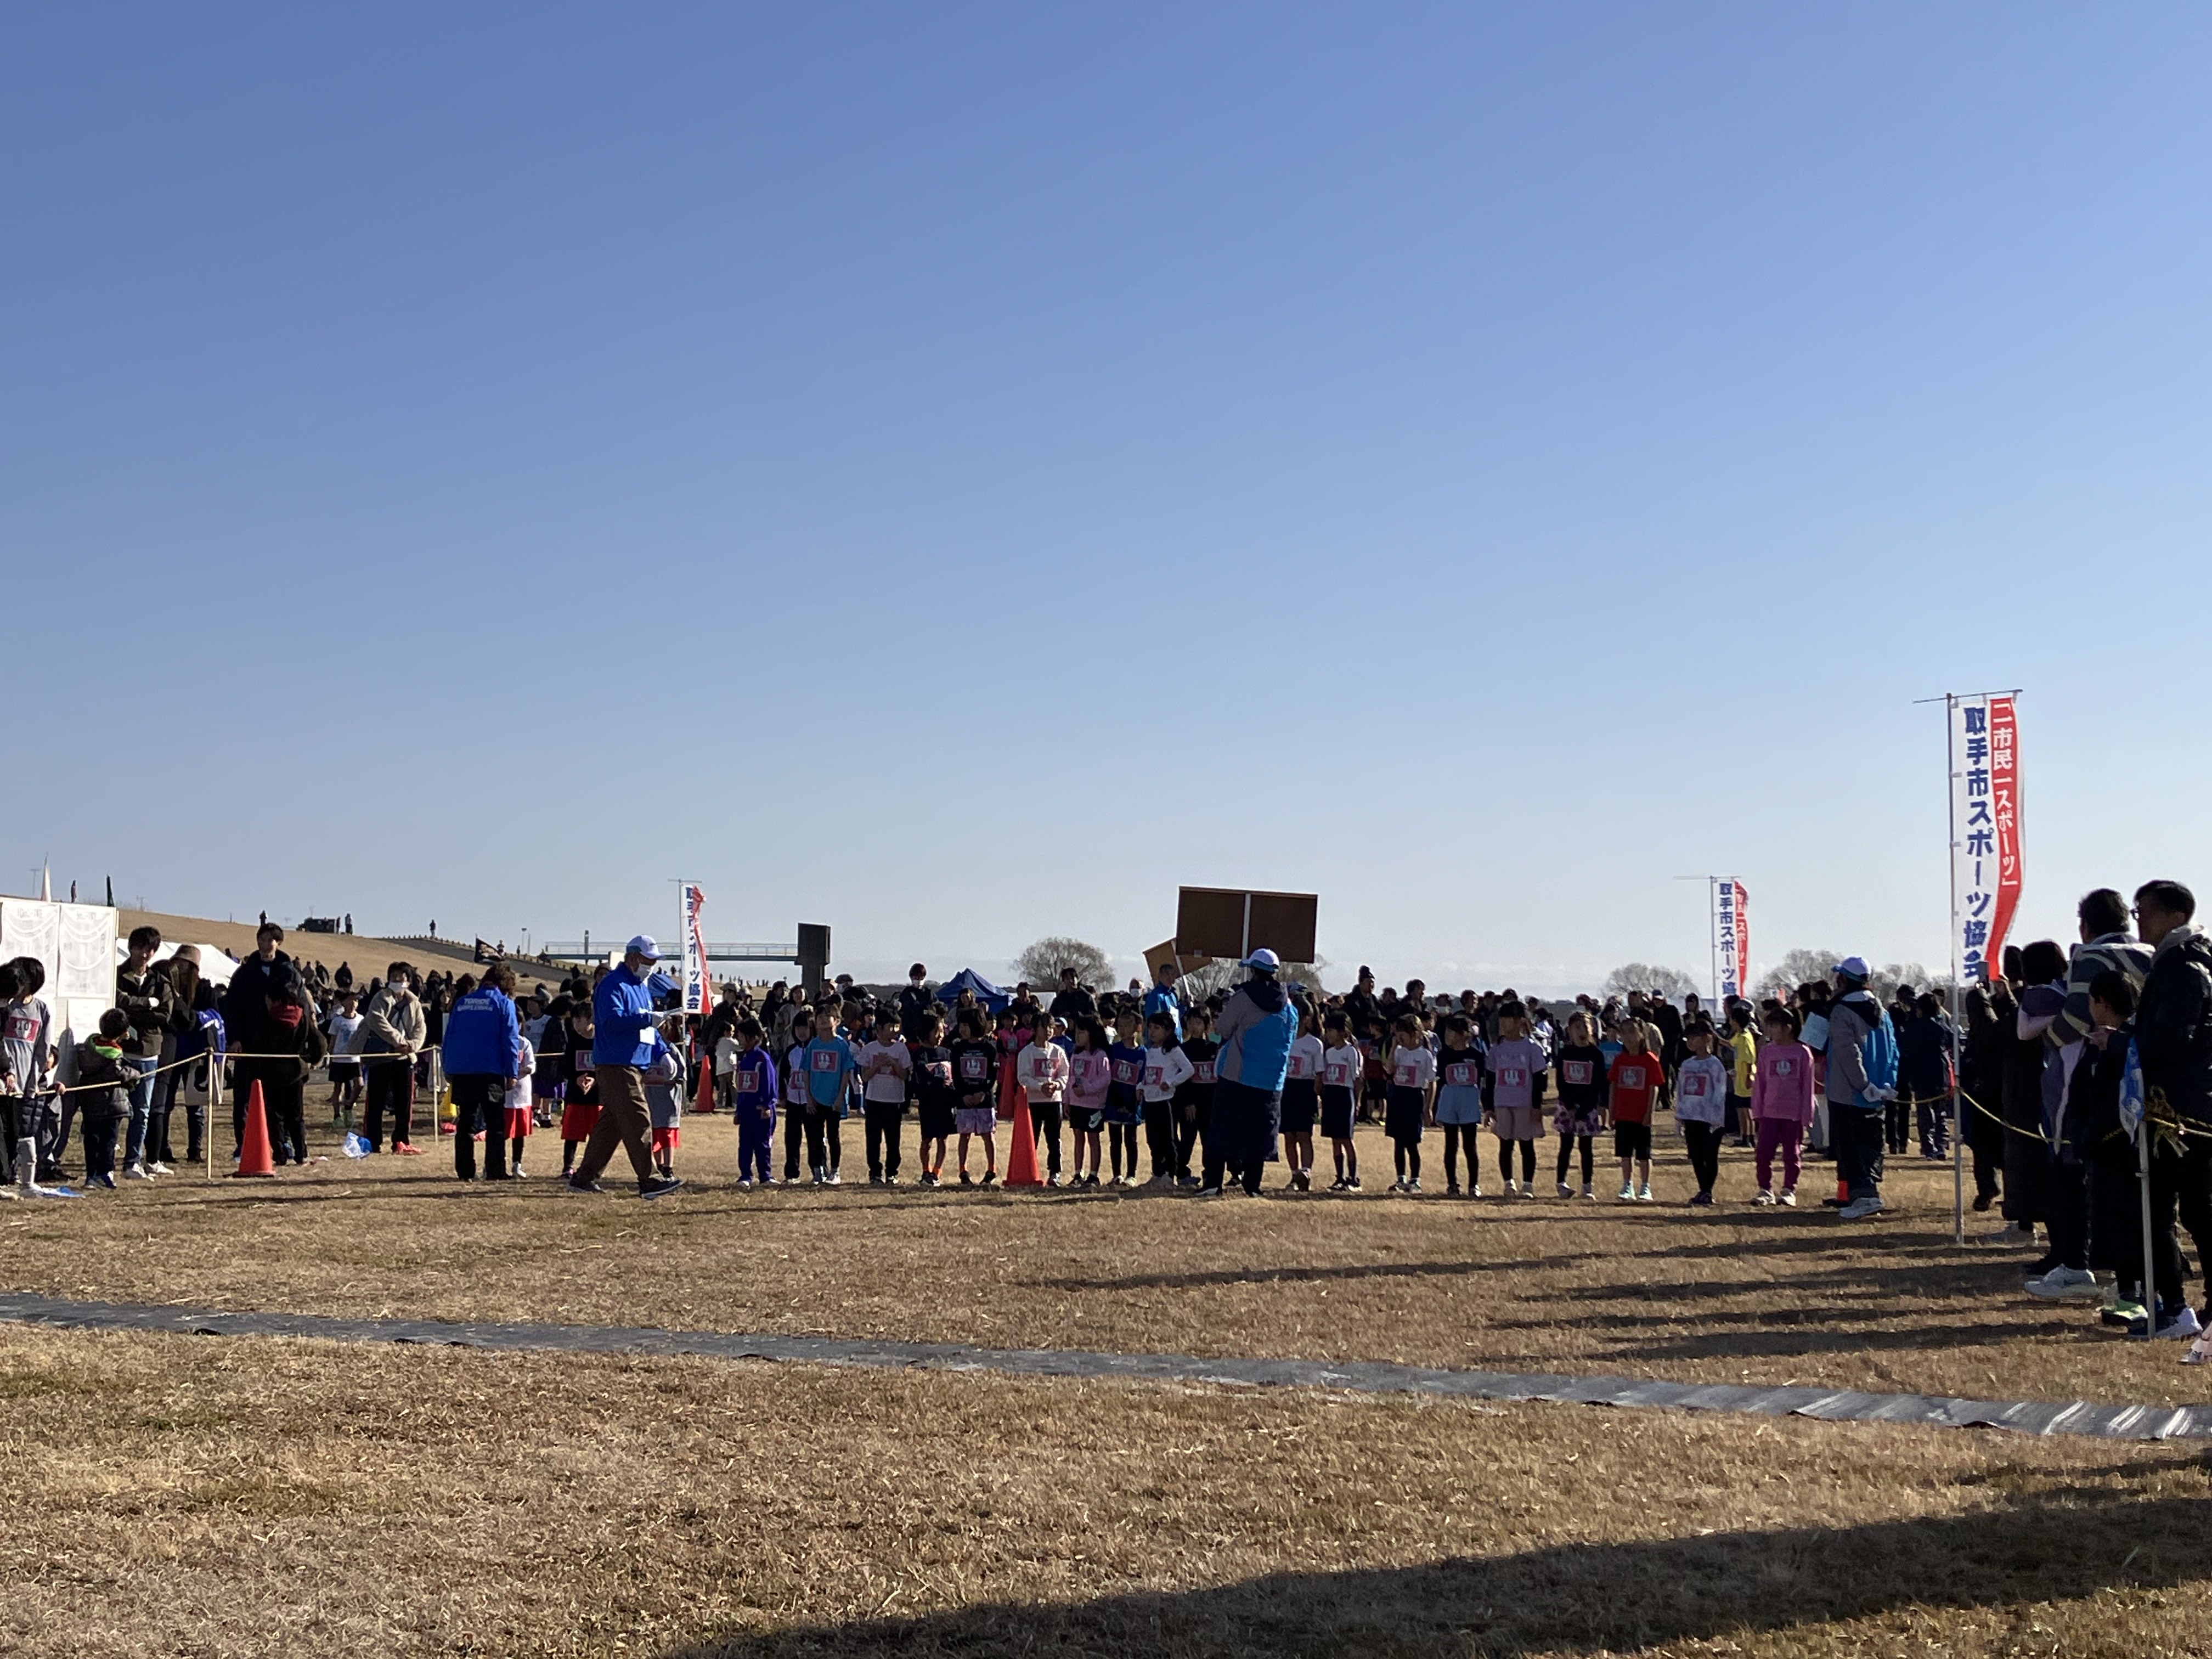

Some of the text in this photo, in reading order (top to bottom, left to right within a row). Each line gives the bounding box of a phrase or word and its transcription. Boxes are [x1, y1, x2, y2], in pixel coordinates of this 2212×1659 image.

[1719, 883, 1737, 1008] 取手市スポーツ協
